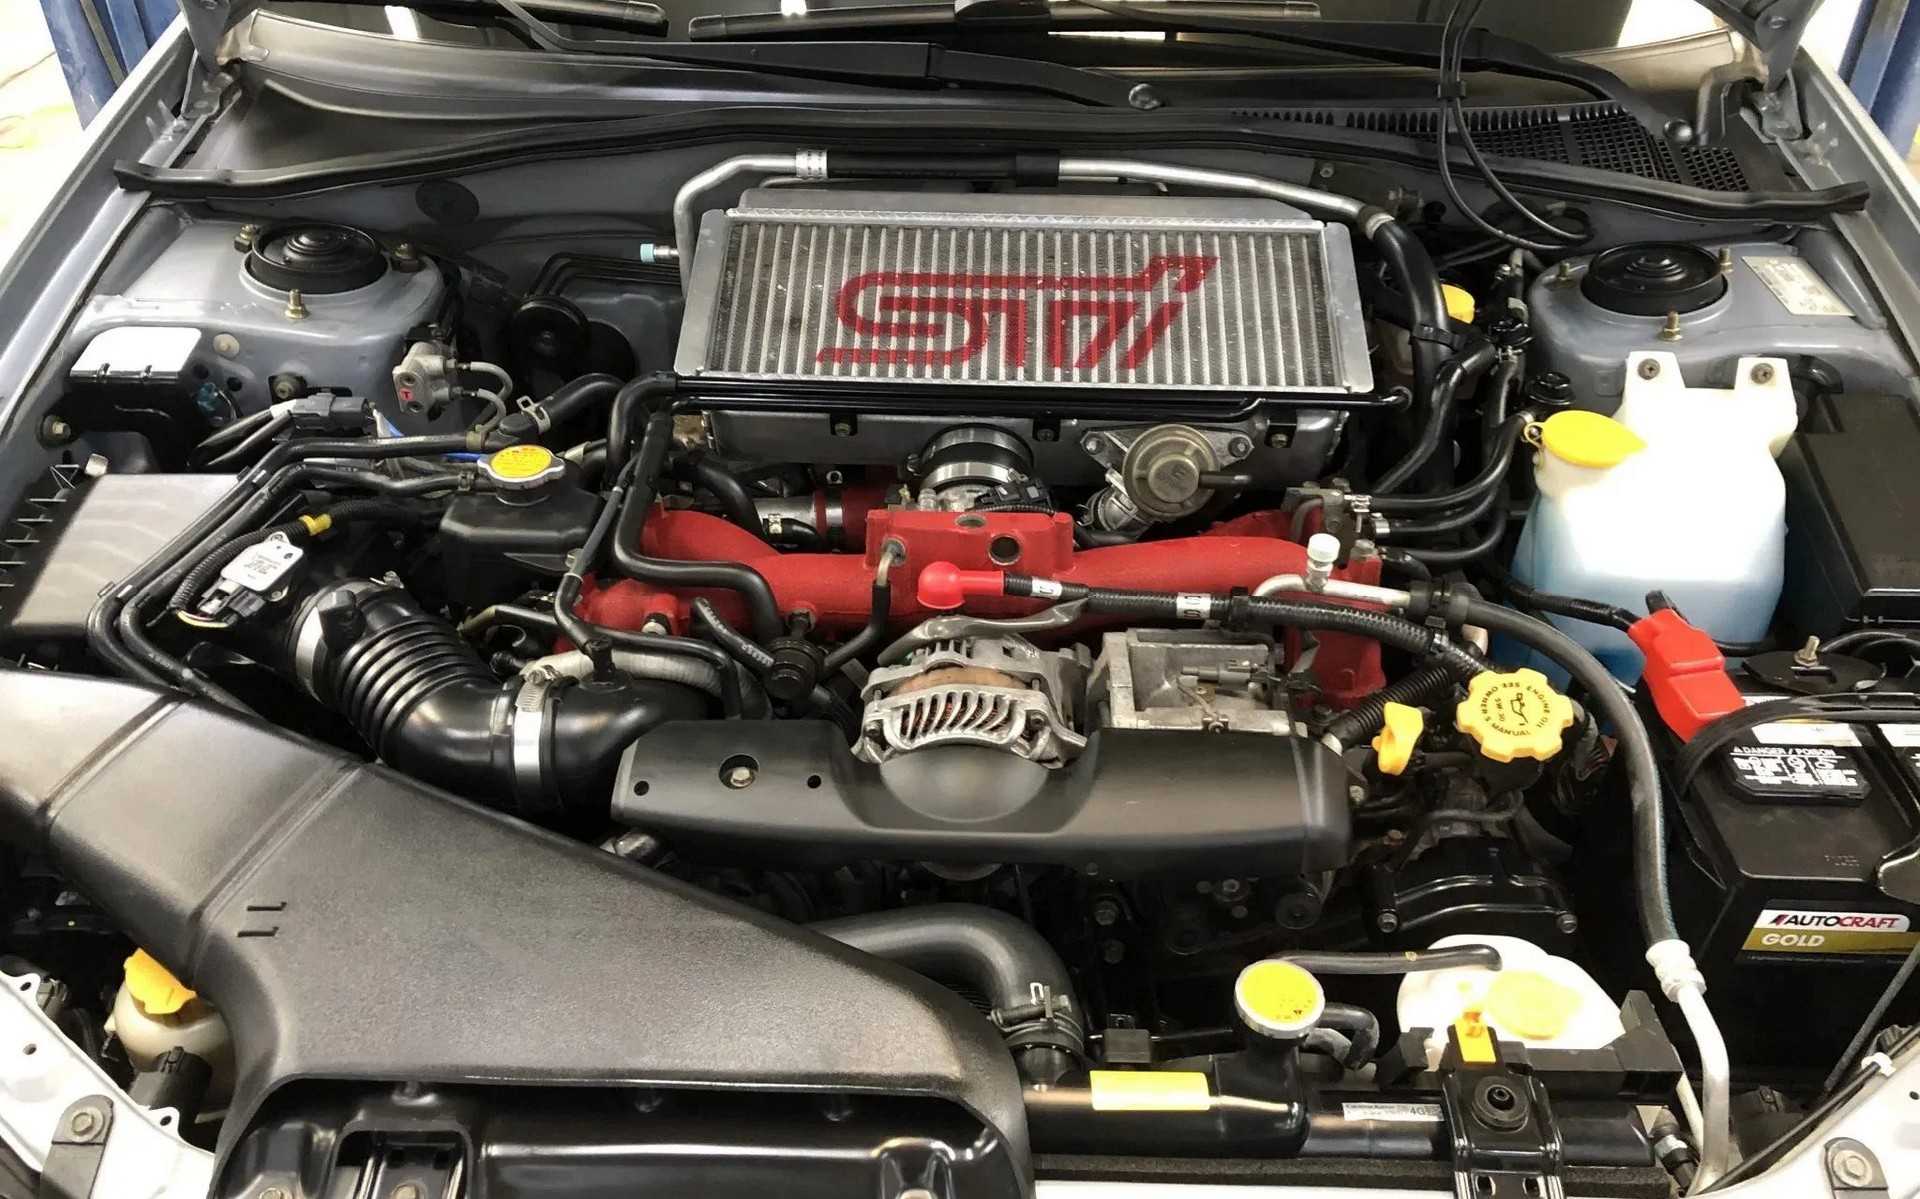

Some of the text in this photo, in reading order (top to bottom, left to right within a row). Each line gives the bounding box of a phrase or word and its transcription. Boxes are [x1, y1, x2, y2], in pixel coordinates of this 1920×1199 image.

[1526, 685, 1551, 729] ENGINE OIL
[1491, 722, 1531, 737] MANUAL
[1745, 747, 1786, 755] DANGER
[1795, 748, 1837, 757] POISON
[1783, 914, 1899, 929] AUTOCRAFT
[1761, 933, 1825, 947] GOLD
